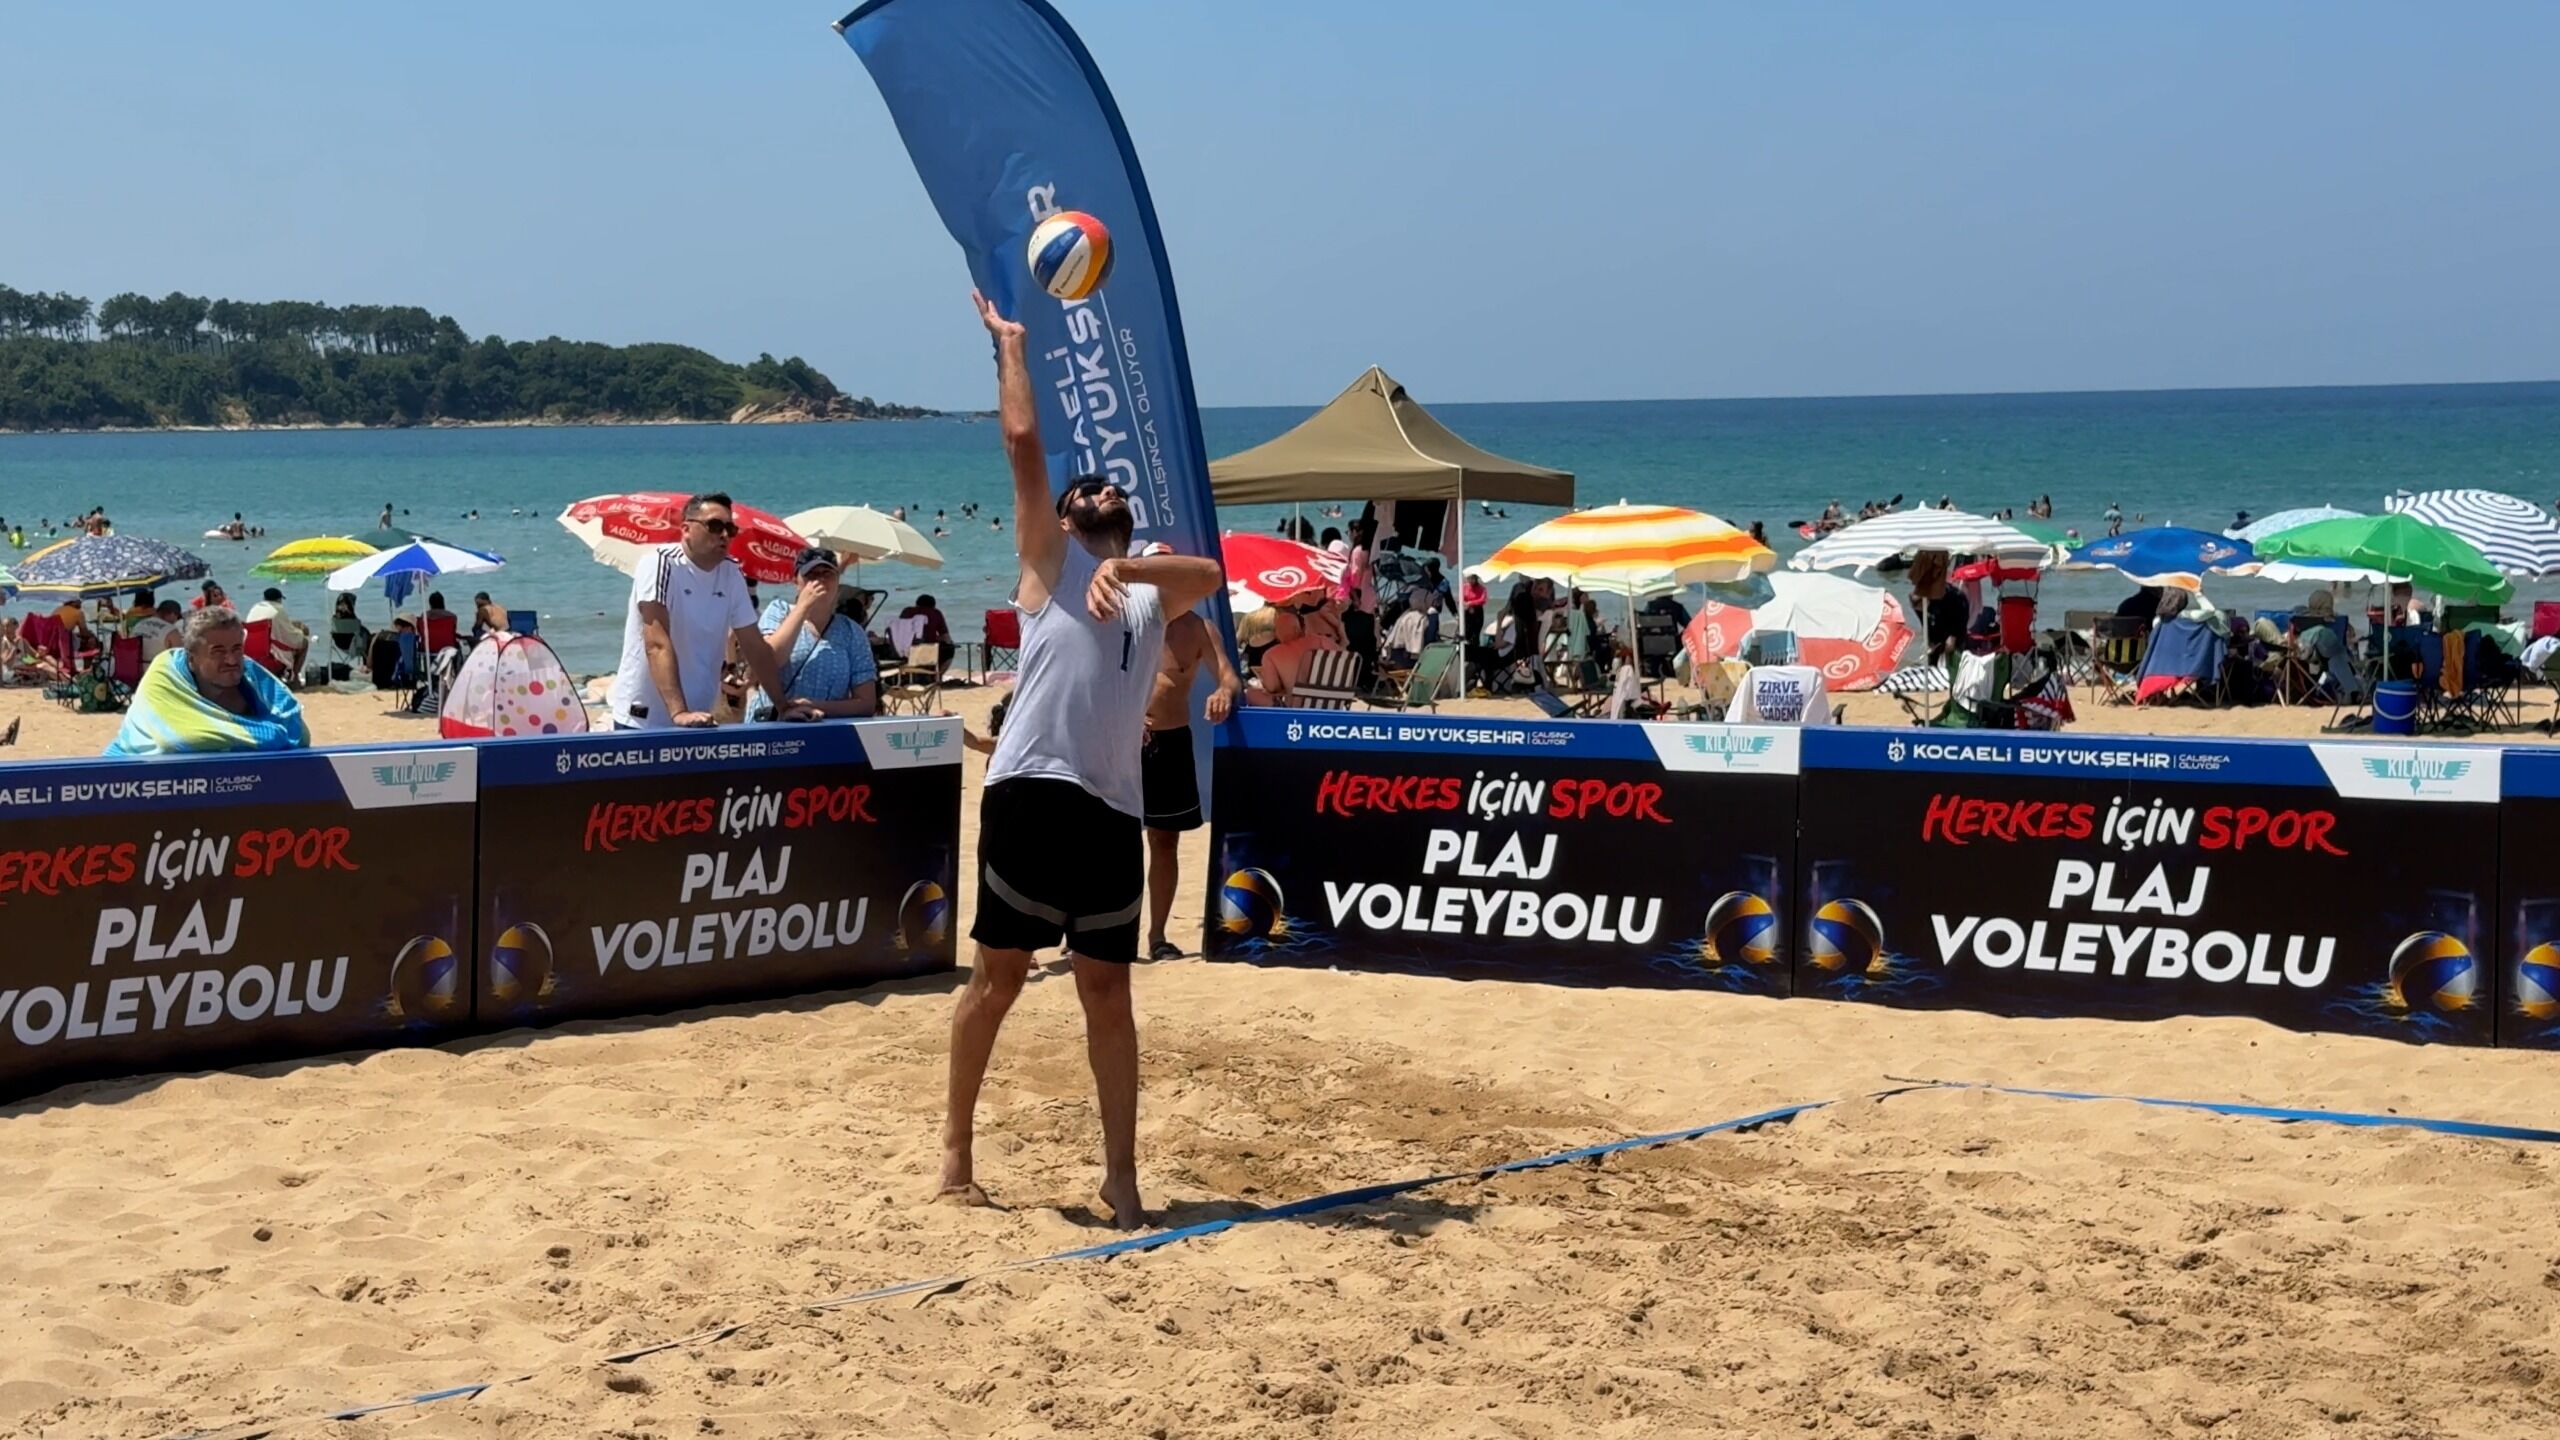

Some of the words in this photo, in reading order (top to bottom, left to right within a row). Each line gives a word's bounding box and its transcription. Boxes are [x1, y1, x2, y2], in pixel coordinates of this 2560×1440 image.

[1027, 181, 1150, 529] BÜYÜKŞR
[1120, 328, 1151, 413] OLUYOR
[1045, 346, 1096, 476] CAELİ
[0, 786, 53, 806] AELİ
[1316, 770, 1462, 818] HERKES
[1467, 770, 1546, 822] İÇİN
[1548, 778, 1673, 824] SPOR
[2387, 760, 2448, 779] KILAVUZ
[583, 797, 716, 852] HERKES
[719, 785, 783, 839] İÇİN
[784, 785, 877, 829] SPOR
[1921, 793, 2095, 845] HERKES
[2102, 795, 2189, 851] İÇİN
[2199, 806, 2349, 856] SPOR
[0, 841, 136, 895] ERKES
[144, 829, 229, 890] İÇİN
[233, 827, 360, 877] SPOR
[681, 846, 792, 903] PLAJ
[1422, 829, 1559, 881] PLAJ
[2048, 859, 2211, 917] PLAJ
[90, 898, 244, 966] PLAJ
[590, 897, 869, 977] VOLEYBOLU
[1323, 881, 1663, 946] VOLEYBOLU
[1930, 913, 2337, 989] VOLEYBOLU
